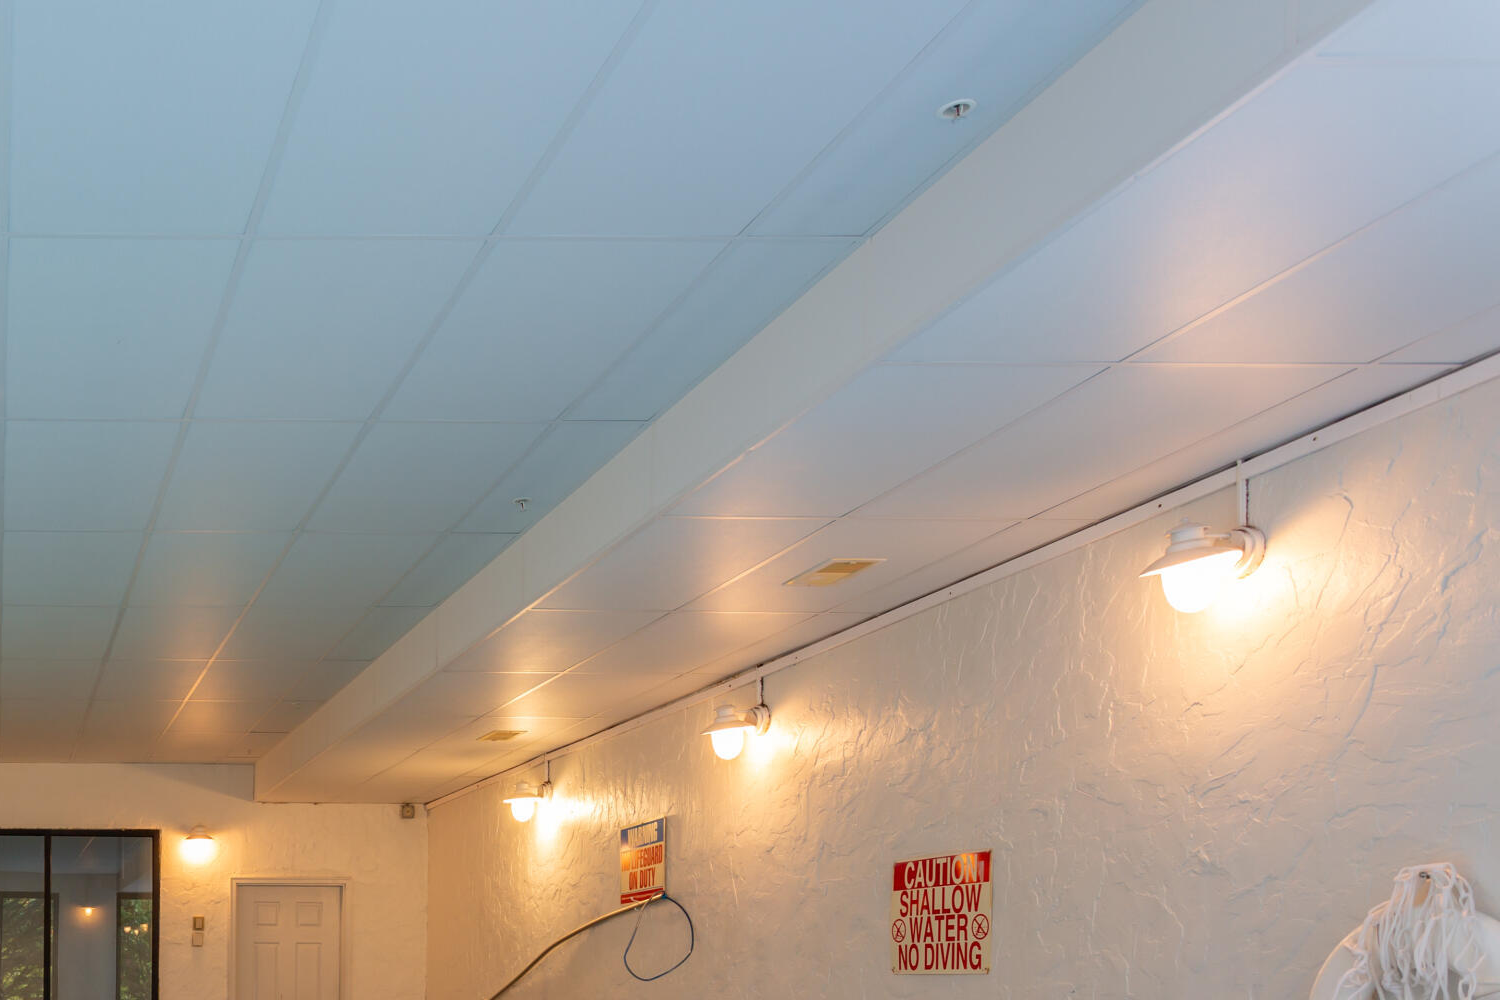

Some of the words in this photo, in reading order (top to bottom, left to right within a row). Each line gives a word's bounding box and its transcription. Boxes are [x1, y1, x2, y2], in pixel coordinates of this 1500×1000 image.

[631, 844, 663, 870] LIFEGUARD
[904, 854, 979, 889] CAUTION
[629, 871, 638, 891] ON
[640, 867, 656, 889] DUTY
[900, 884, 982, 917] SHALLOW
[909, 914, 968, 943] WATER
[898, 943, 919, 971] NO
[924, 941, 982, 970] DIVING
